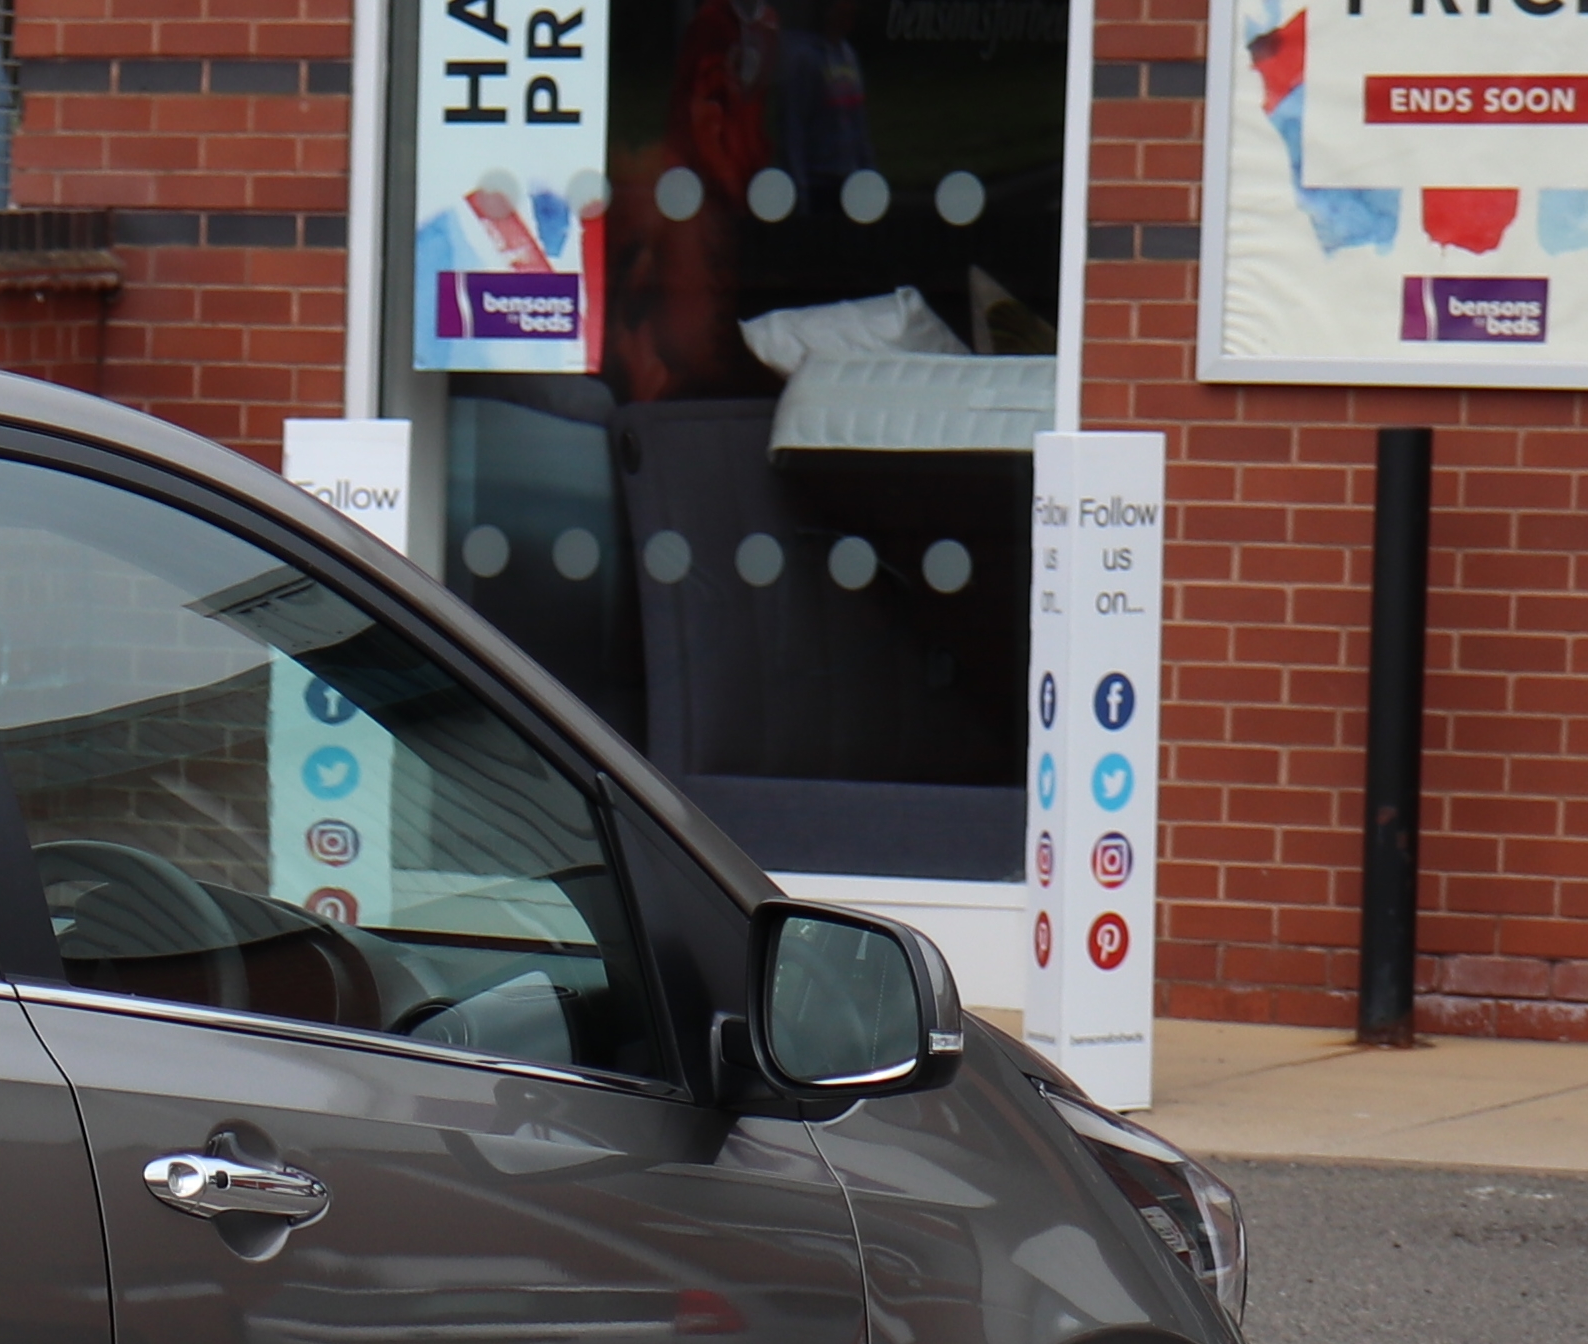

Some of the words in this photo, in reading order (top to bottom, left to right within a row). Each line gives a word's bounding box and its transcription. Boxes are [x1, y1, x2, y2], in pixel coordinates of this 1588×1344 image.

[1389, 87, 1473, 112] ENDS
[1484, 87, 1576, 113] SOON
[482, 291, 574, 313] bensons
[1448, 295, 1542, 317] bensons
[519, 313, 573, 332] beds
[1486, 316, 1541, 335] beds
[294, 479, 400, 509] ollow
[1079, 495, 1158, 527] Follow
[1102, 547, 1132, 571] us
